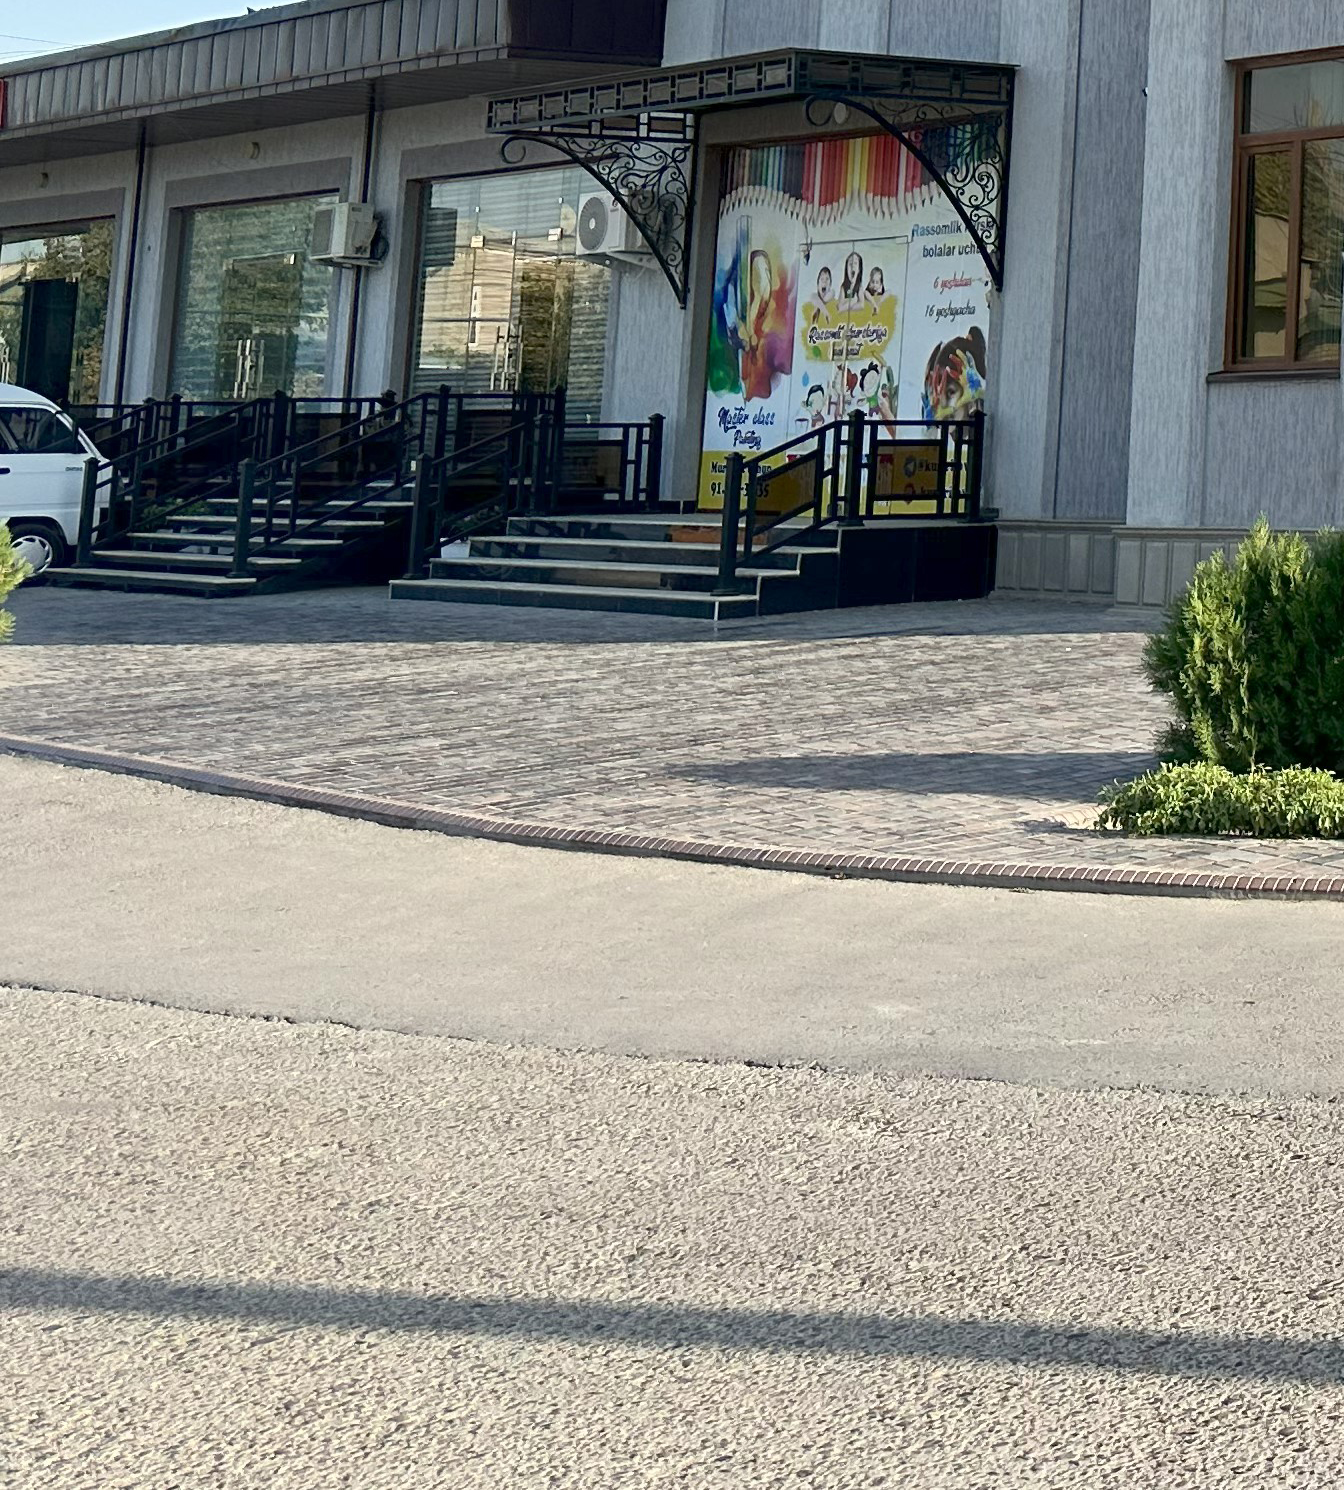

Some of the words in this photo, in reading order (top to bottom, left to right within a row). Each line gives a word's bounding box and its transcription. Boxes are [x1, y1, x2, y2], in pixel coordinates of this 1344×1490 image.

[912, 220, 962, 237] Rassomlik
[922, 243, 956, 258] bolalar
[957, 241, 981, 256] uch
[924, 304, 936, 317] 16
[717, 406, 750, 433] Master
[752, 406, 776, 426] class
